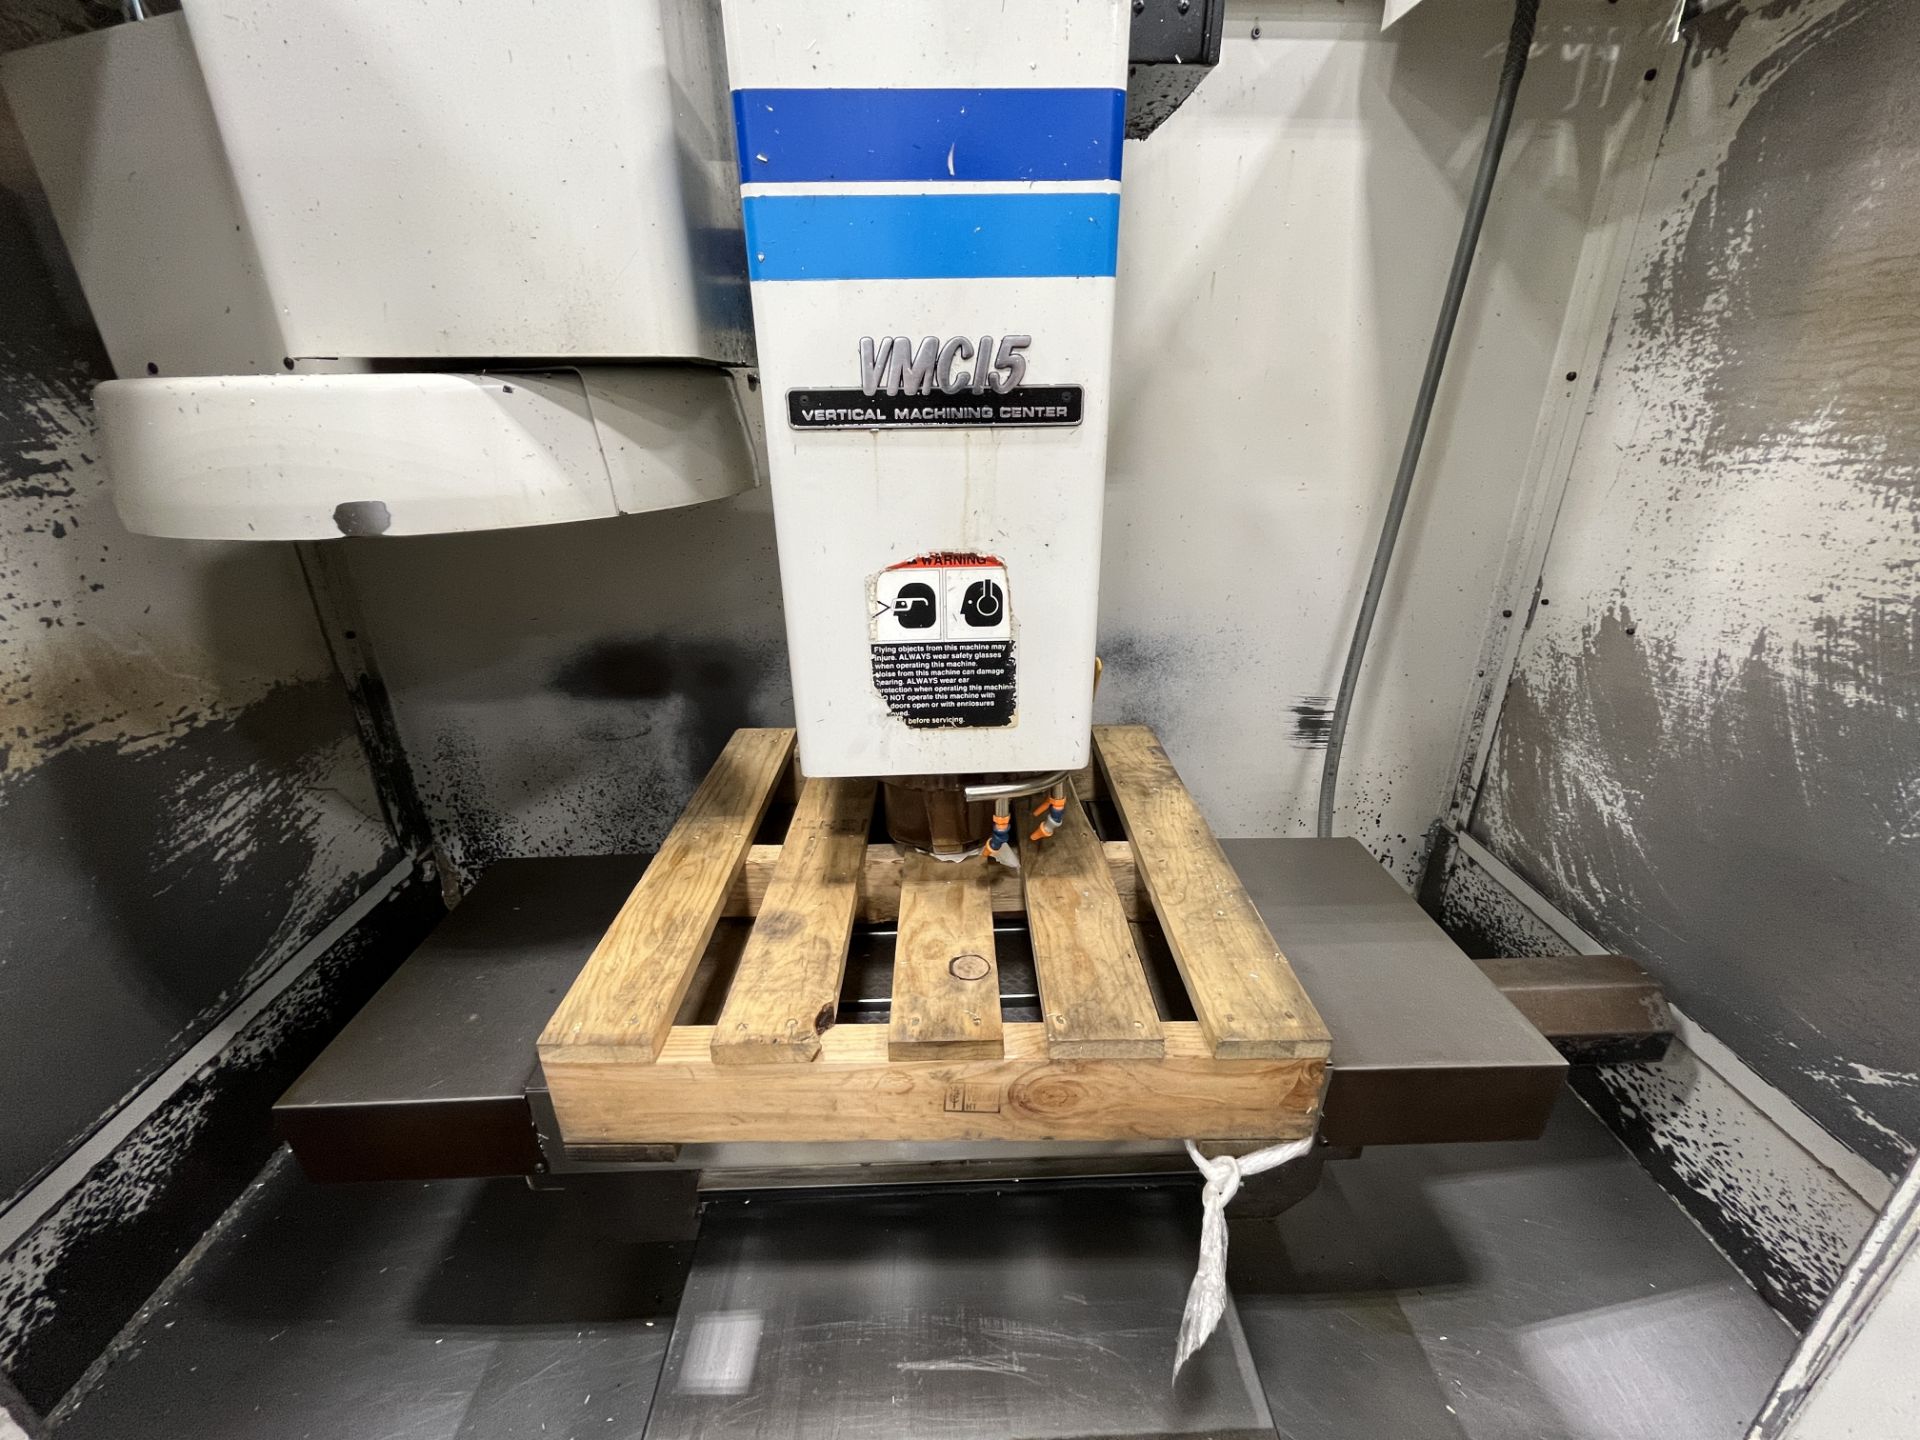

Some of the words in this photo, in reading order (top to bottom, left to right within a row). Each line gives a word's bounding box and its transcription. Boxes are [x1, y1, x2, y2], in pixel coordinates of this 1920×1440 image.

[858, 335, 1032, 396] VMC15
[802, 408, 887, 421] VERTICAL
[894, 406, 993, 420] MACHINING
[999, 405, 1068, 418] CENTER
[921, 553, 987, 566] WARNING
[873, 646, 897, 654] Flying
[898, 645, 924, 653] objects
[959, 643, 990, 651] machine
[991, 644, 1007, 652] may
[899, 653, 931, 661] ALWAYS
[951, 652, 973, 660] safety
[974, 652, 1002, 660] glasses
[896, 661, 930, 670] operating
[931, 660, 945, 668] this
[946, 660, 978, 668] machine.
[930, 668, 961, 676] machine
[976, 668, 1005, 676] damage
[906, 677, 938, 685] ALWAYS
[880, 686, 913, 694] rotection
[914, 685, 933, 693] when
[934, 684, 968, 693] operating
[907, 694, 934, 702] operate
[949, 692, 980, 700] machine
[890, 702, 911, 710] doors
[911, 702, 930, 710] open
[956, 700, 995, 708] enclosures
[931, 717, 965, 725] servicing.
